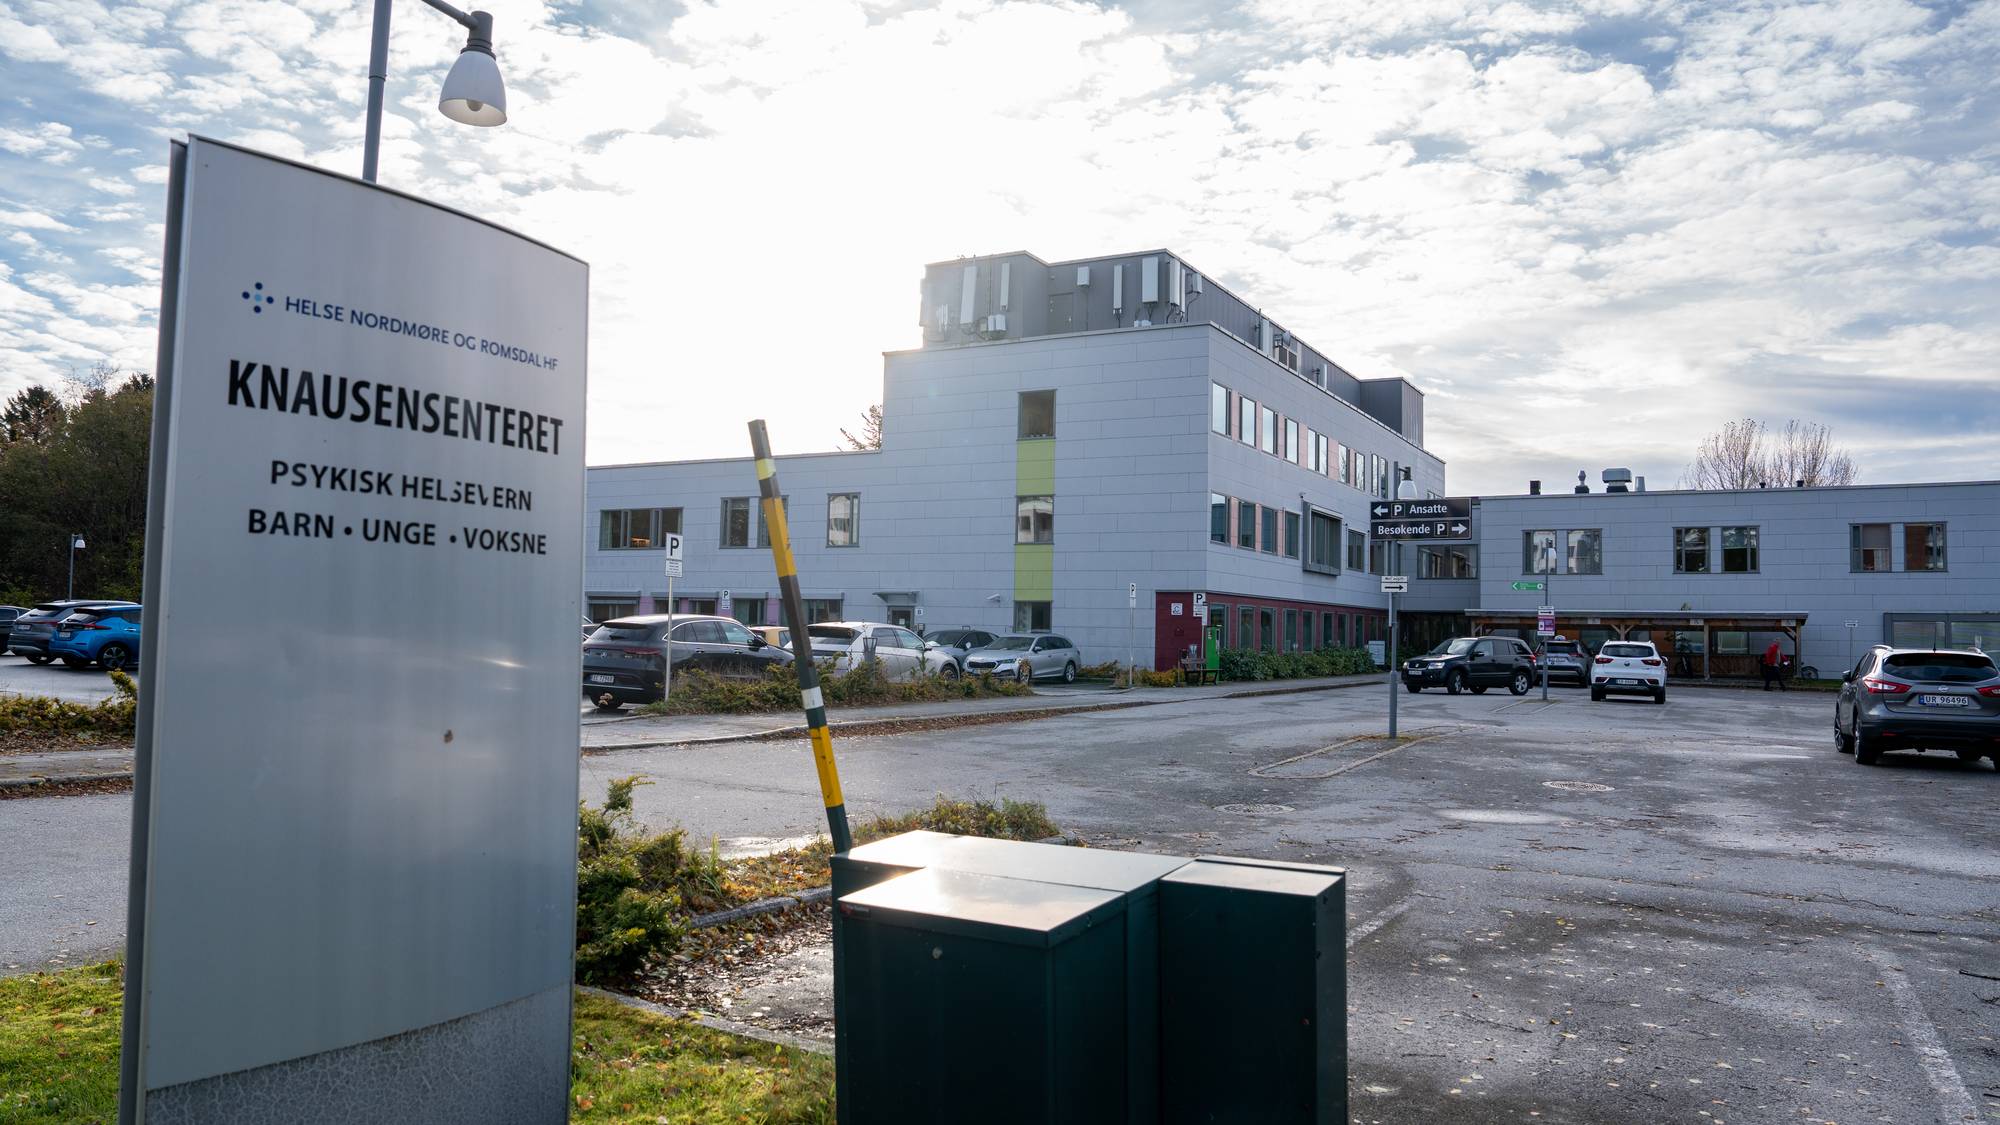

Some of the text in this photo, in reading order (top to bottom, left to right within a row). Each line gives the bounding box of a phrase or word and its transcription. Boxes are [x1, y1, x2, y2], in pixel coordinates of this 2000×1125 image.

[285, 296, 558, 370] HELSE NORDMØRE OG ROMSDAL HF
[228, 359, 563, 455] KNAUSENSENTERET
[271, 460, 393, 496] PSYKISK
[1394, 504, 1448, 516] P Ansatte
[249, 509, 547, 555] BARN UNGE VOKSNE
[1378, 524, 1445, 535] Besøkende P
[670, 537, 679, 556] P
[723, 590, 729, 598] P
[1196, 594, 1203, 603] P
[1940, 696, 1967, 705] 96496
